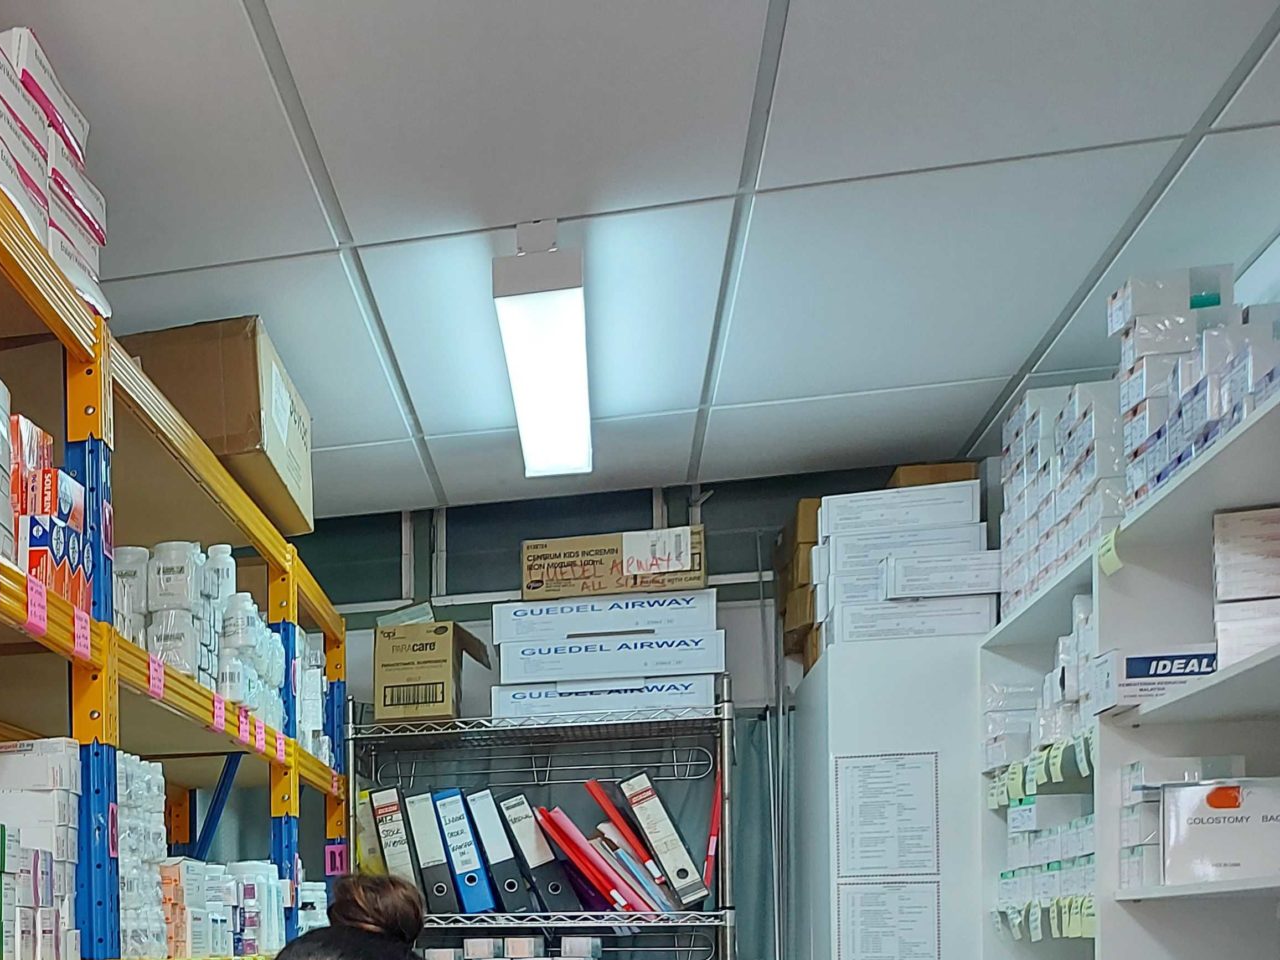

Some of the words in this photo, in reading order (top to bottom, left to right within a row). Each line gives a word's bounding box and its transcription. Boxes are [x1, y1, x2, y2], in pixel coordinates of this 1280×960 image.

[513, 605, 604, 617] GUEDEL
[608, 596, 696, 611] AIRWAY
[521, 644, 609, 656] GUEDEL
[616, 638, 704, 651] AIRWAY
[1187, 816, 1251, 825] COLOSTOMY
